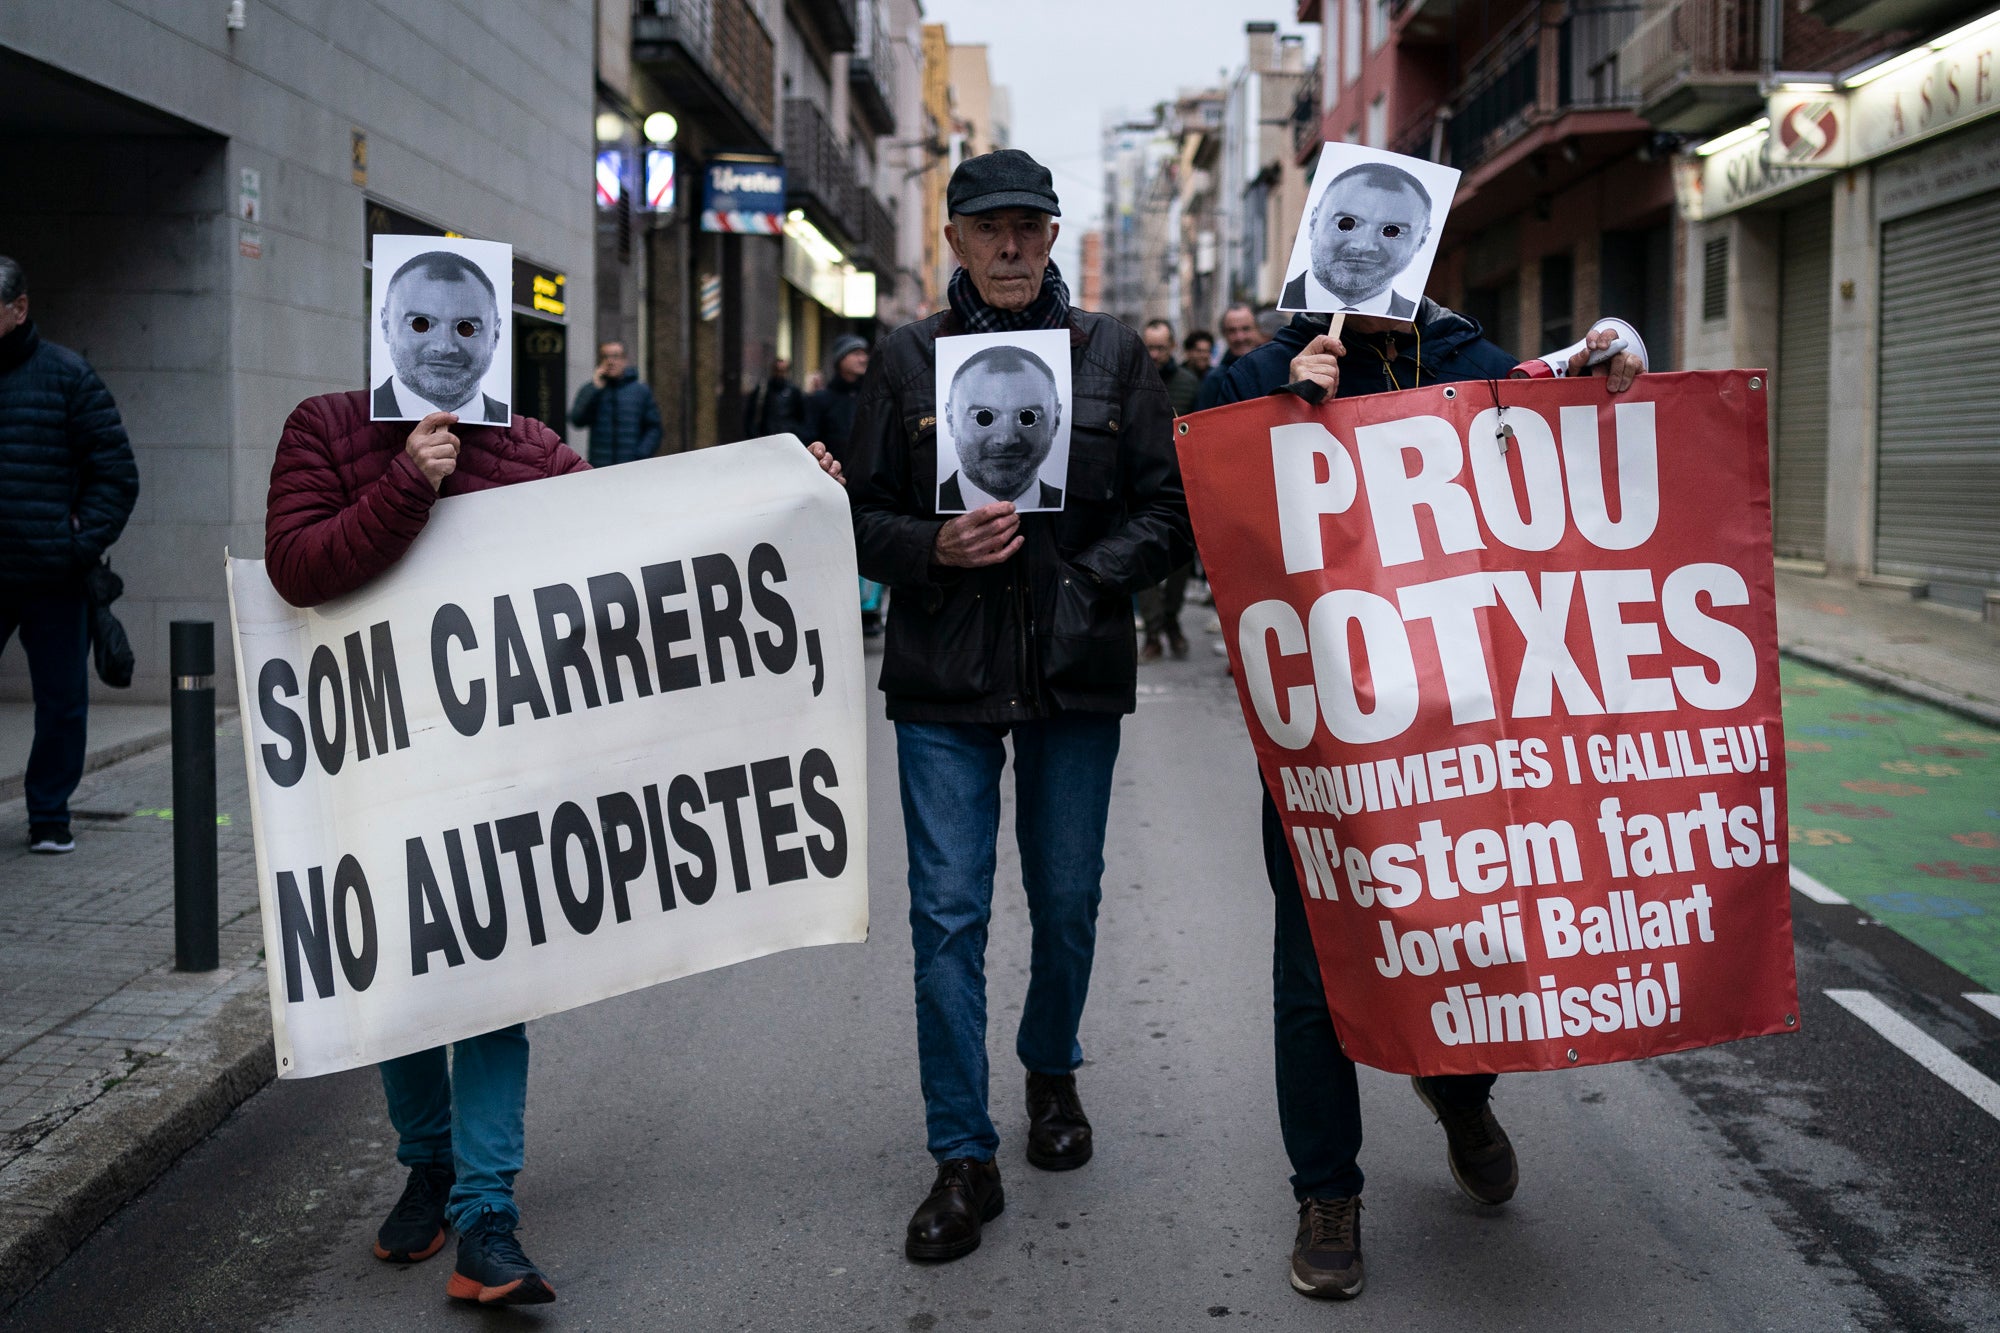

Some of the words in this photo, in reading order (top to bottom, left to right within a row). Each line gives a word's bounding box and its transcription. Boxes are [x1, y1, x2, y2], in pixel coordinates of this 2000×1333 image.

[1269, 401, 1660, 575] PROU
[258, 620, 411, 788] SOM
[430, 542, 824, 737] CARRERS,
[1238, 562, 1758, 750] COTXES
[1279, 736, 1553, 822] ARQUIMEDES
[1561, 735, 1583, 786] I
[1586, 725, 1770, 784] GALILEU!
[275, 853, 378, 1004] NO
[405, 747, 848, 977] AUTOPISTES
[1292, 816, 1584, 909] N'estem
[1598, 787, 1780, 880] farts!
[1374, 900, 1527, 979] Jordi
[1536, 884, 1715, 960] Ballart
[1430, 962, 1681, 1047] dimissió!
